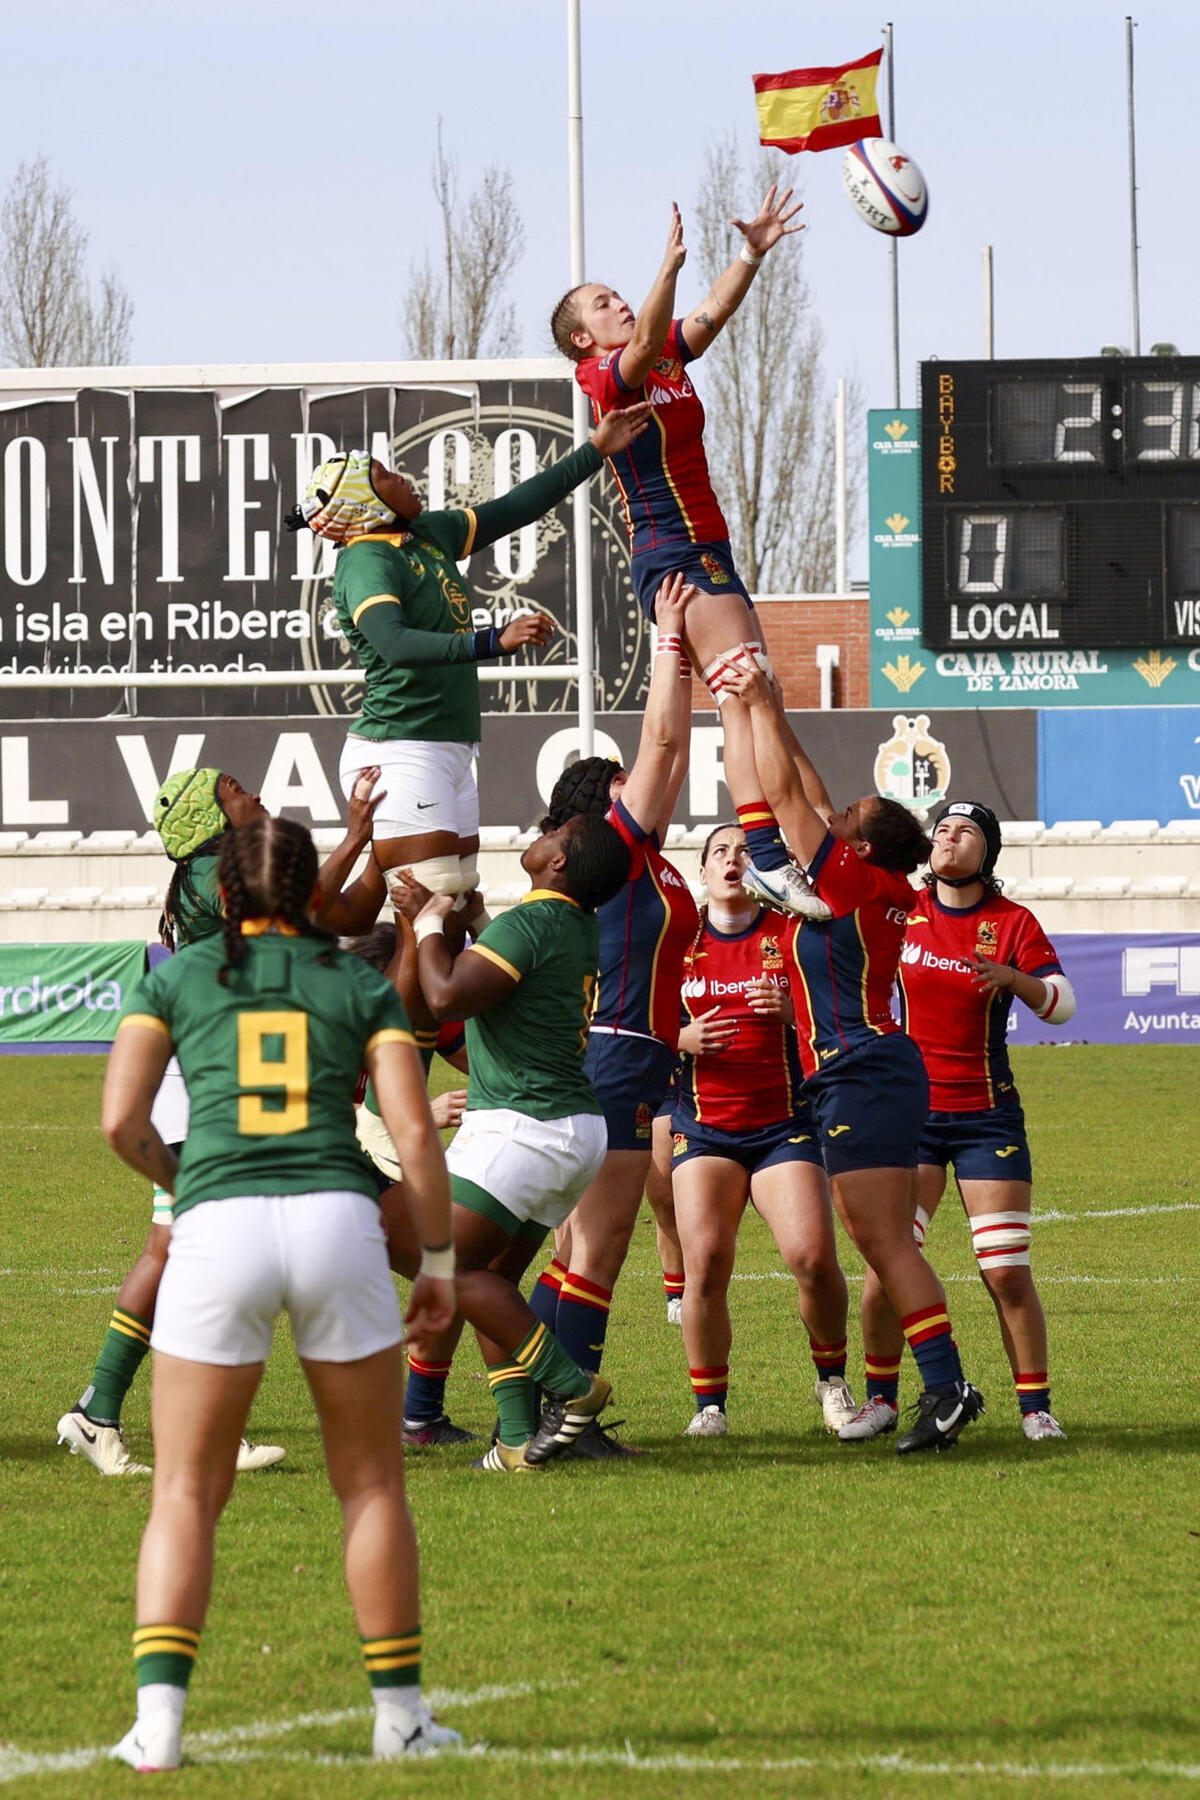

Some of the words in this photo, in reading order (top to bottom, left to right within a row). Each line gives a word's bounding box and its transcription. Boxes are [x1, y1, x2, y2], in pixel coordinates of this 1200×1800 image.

[4, 427, 537, 587] ONTECO
[15, 602, 89, 642] isla
[100, 611, 153, 642] en
[167, 600, 312, 641] Ribera
[950, 602, 1060, 640] LOCAL
[935, 652, 1006, 677] CAJA
[1011, 650, 1108, 675] RURAL
[966, 675, 993, 692] DE
[999, 674, 1079, 692] ZAMORA
[237, 1011, 309, 1135] 9
